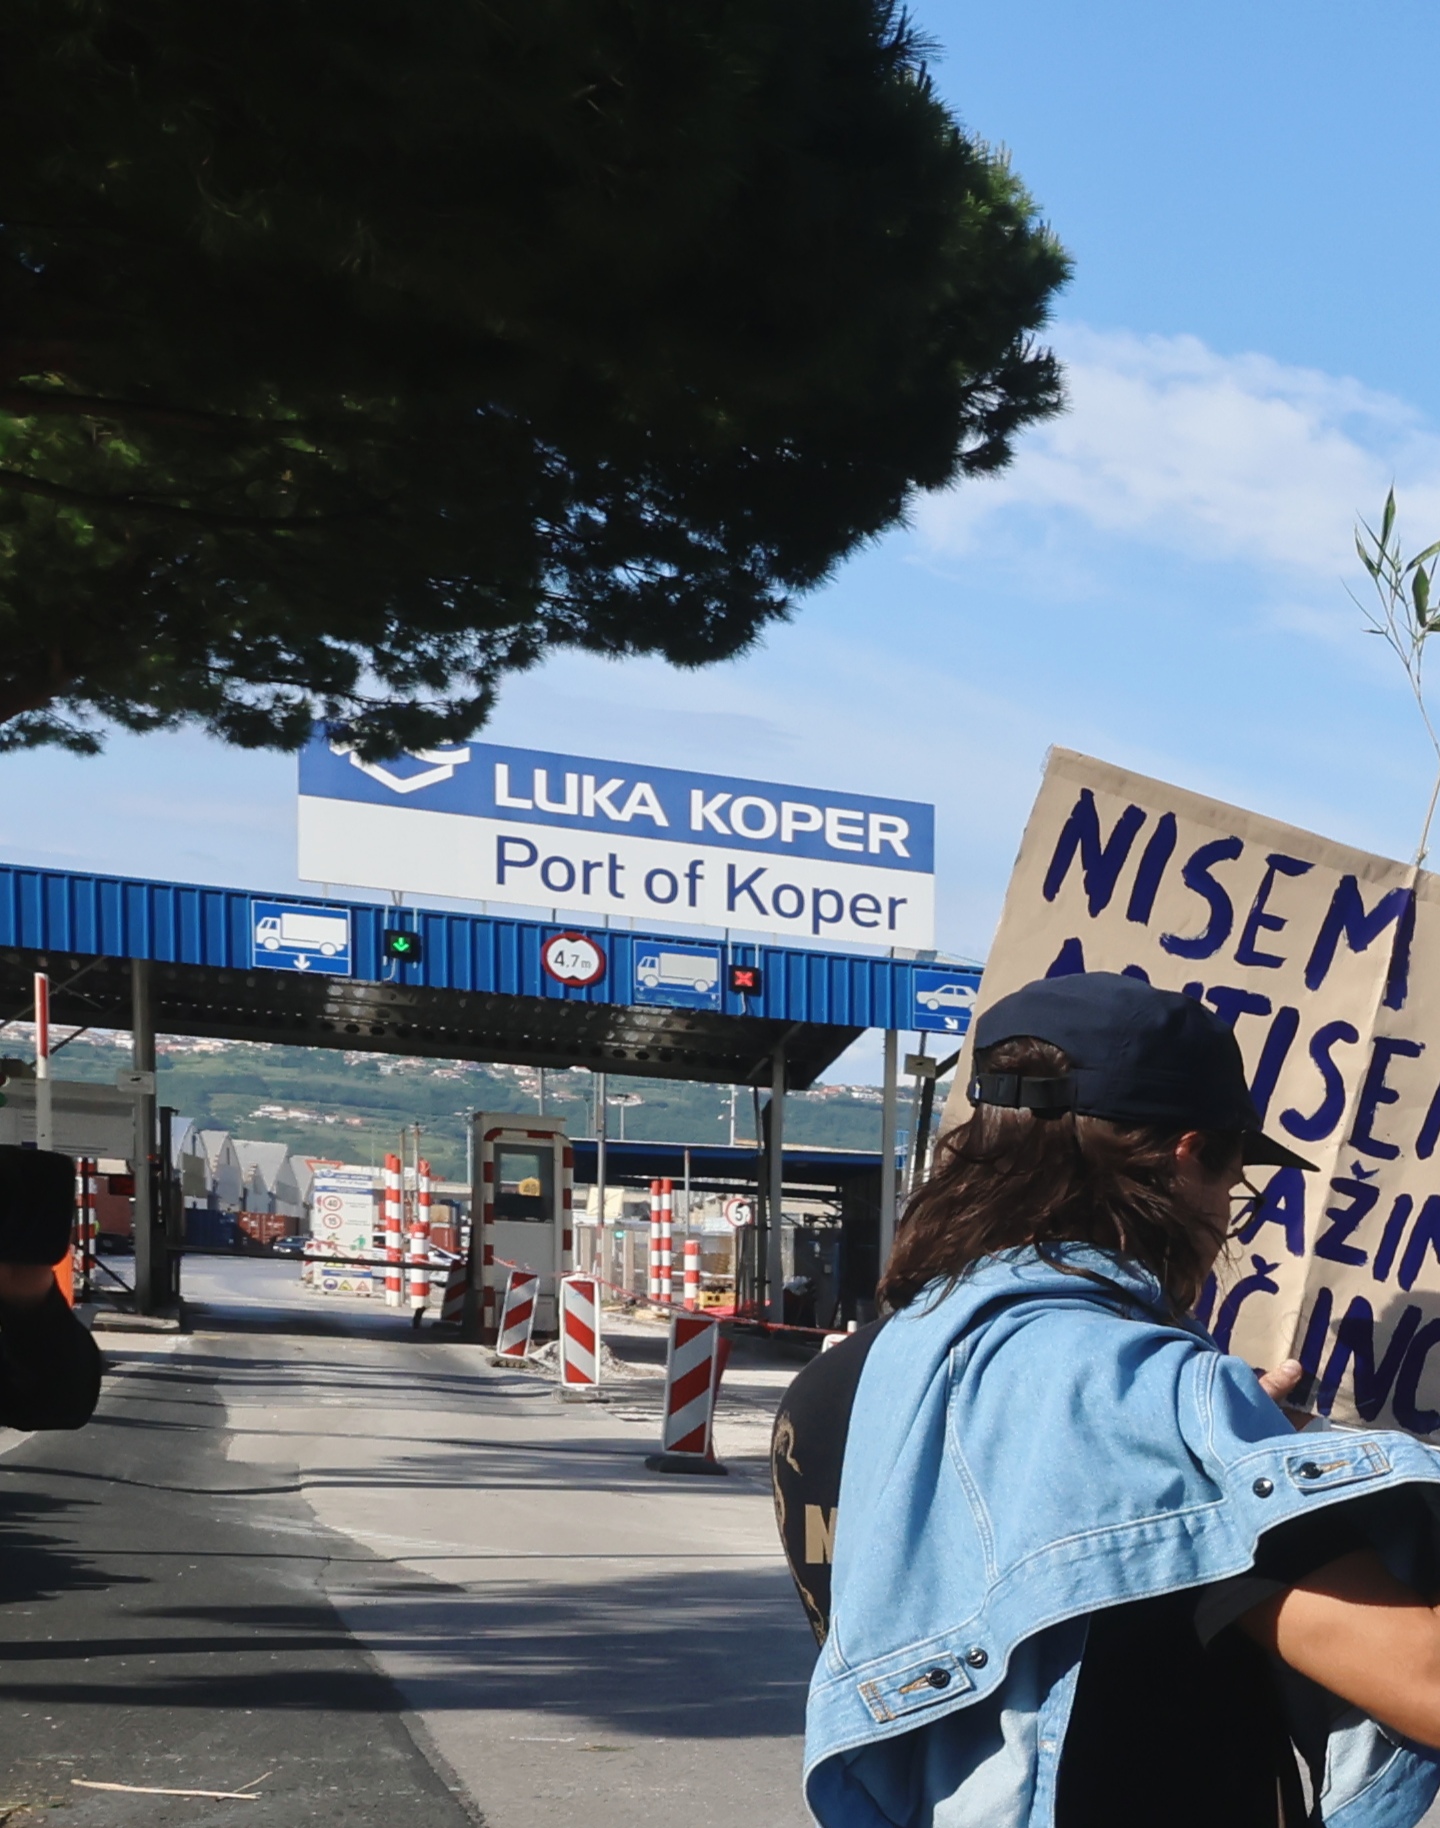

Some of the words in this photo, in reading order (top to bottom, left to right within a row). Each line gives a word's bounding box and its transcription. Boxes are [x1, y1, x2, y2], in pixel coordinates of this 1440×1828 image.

[494, 763, 669, 828] LUKA
[690, 788, 911, 858] KOPER
[496, 834, 626, 899] Port
[643, 859, 705, 908] of
[726, 863, 908, 936] Koper
[1042, 788, 1417, 1010] NISEM
